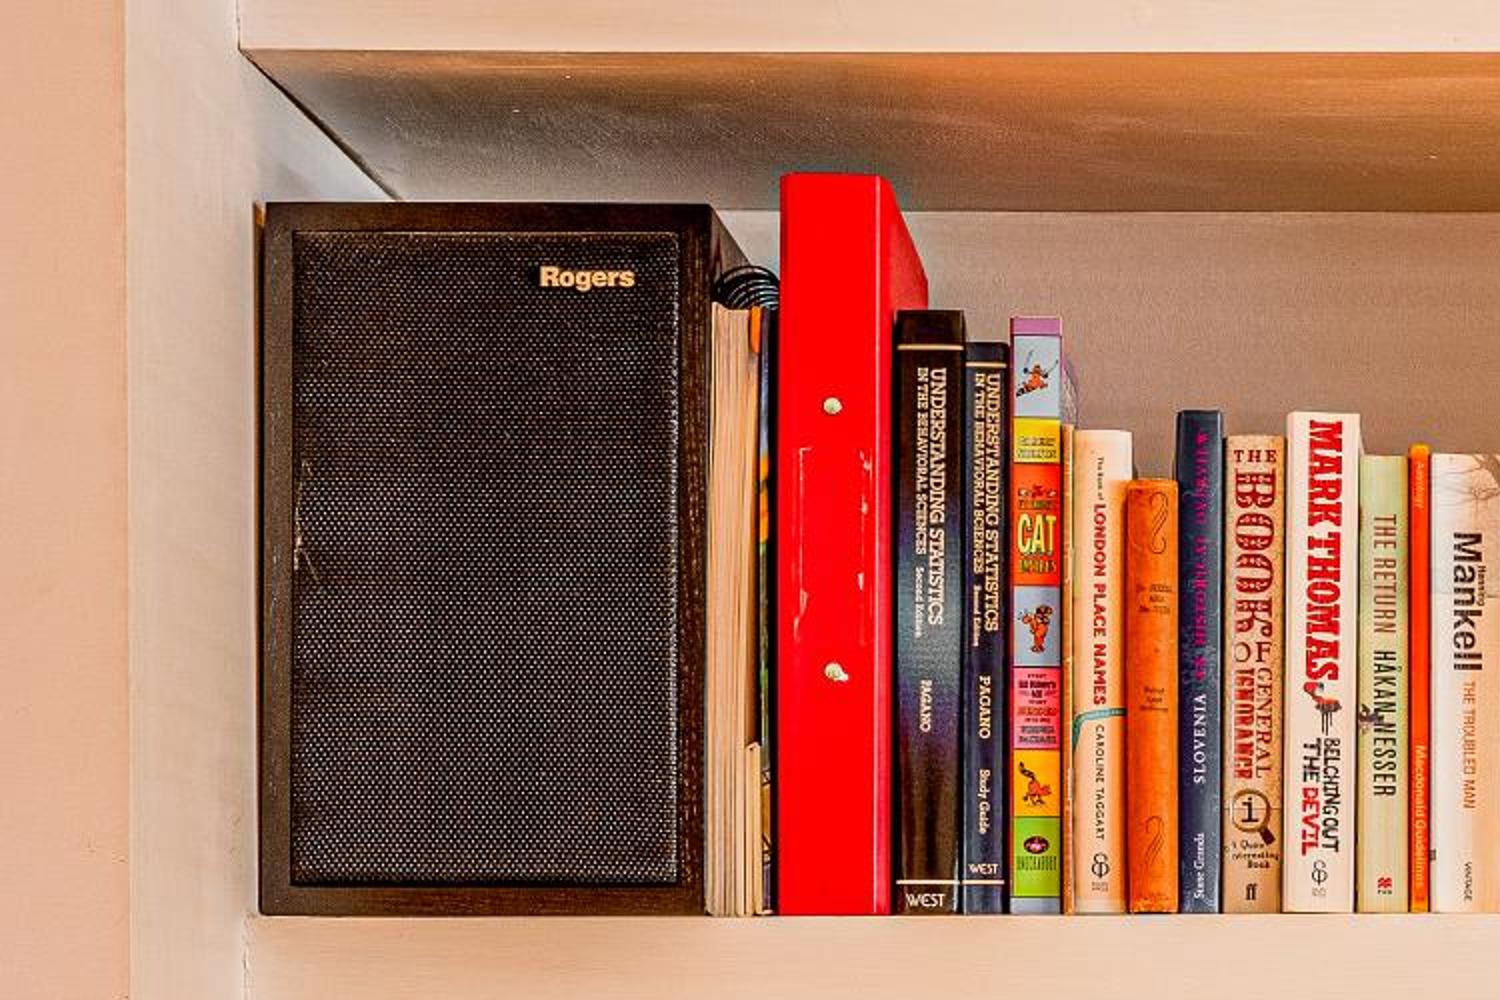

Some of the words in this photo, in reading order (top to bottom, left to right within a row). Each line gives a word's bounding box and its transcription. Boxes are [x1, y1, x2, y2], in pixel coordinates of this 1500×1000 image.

[540, 265, 635, 291] Rogers
[928, 368, 946, 524] UNDERSTANDING
[1234, 450, 1277, 463] THE
[1308, 420, 1343, 527] MARK
[1094, 503, 1106, 576] LONDON
[1235, 468, 1276, 637] BOOK
[1374, 514, 1396, 549] THE
[928, 528, 946, 625] STATISTICS
[1094, 583, 1106, 637] PLACE
[1305, 532, 1341, 681] THOMAS
[1374, 558, 1396, 633] RETURN
[1454, 532, 1482, 671] Mankell
[1094, 644, 1106, 704] NAMES
[1232, 641, 1273, 662] OF
[1374, 651, 1400, 712] HÅKAN
[920, 680, 933, 732] PAGANO
[1194, 694, 1206, 784] SLOVENIA
[1234, 668, 1254, 779] IGNORANCE
[1256, 668, 1272, 779] GENERAL
[1096, 725, 1104, 782] CAROLINE
[1302, 739, 1320, 782] THE
[1322, 738, 1339, 818] BELCHING
[1374, 723, 1396, 796] NESSER
[1096, 788, 1104, 840] TAGGART
[1302, 787, 1320, 856] DEVIL
[1322, 820, 1338, 852] OUT
